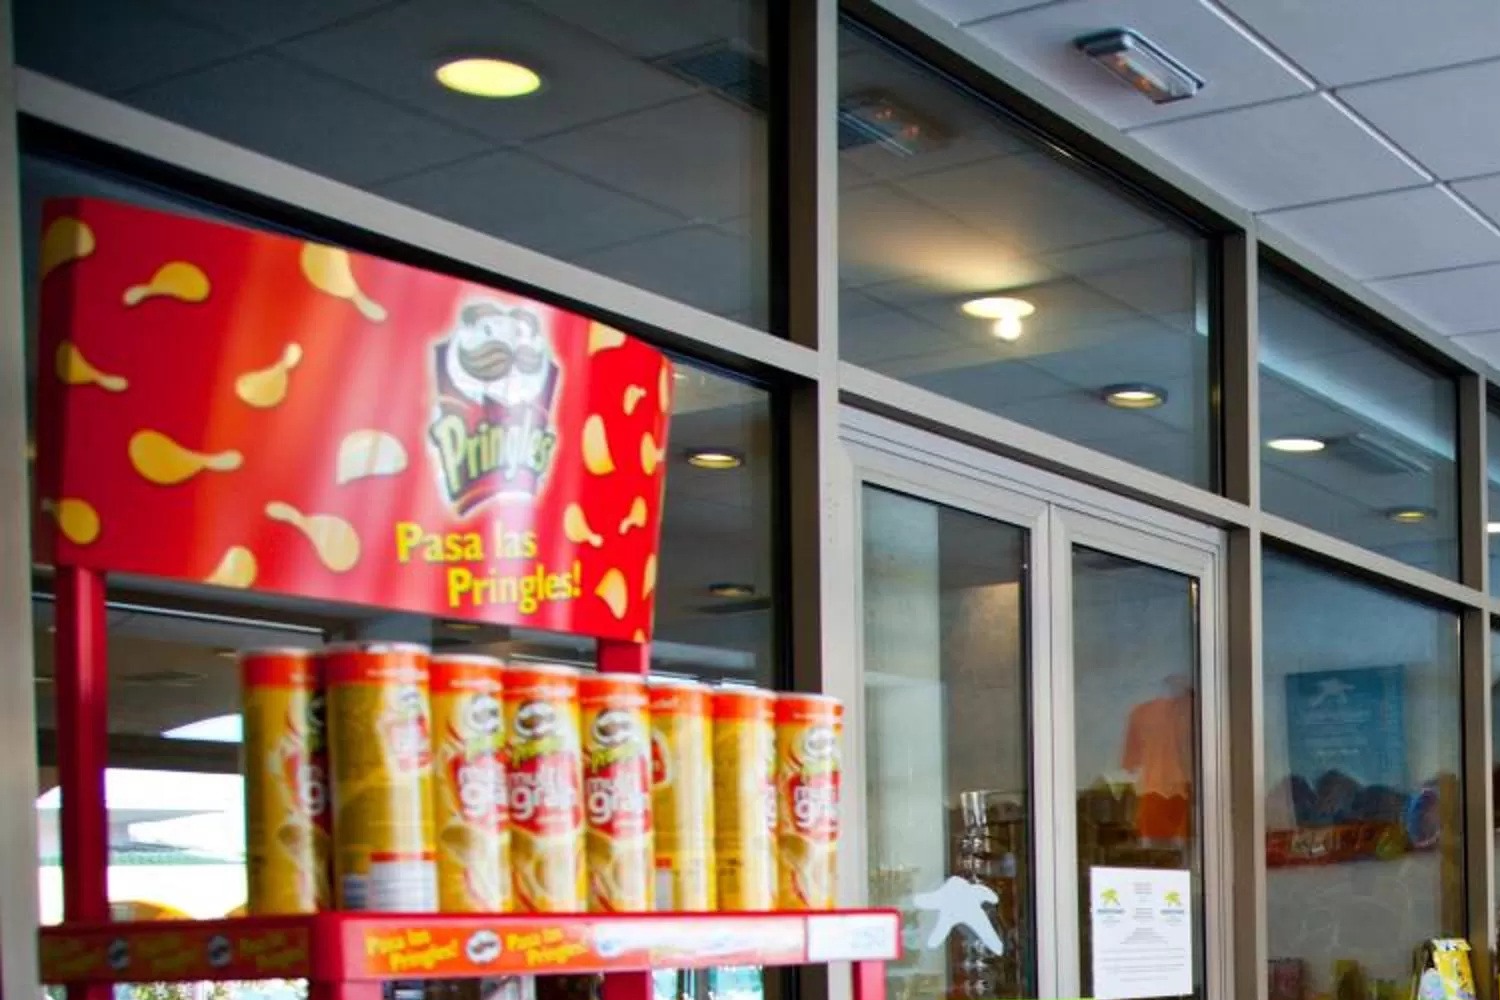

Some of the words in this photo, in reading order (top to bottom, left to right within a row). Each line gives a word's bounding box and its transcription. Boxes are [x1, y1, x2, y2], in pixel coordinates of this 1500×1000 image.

[430, 412, 555, 496] Pringles
[396, 522, 483, 562] Pasa
[493, 521, 537, 557] las
[447, 562, 581, 614] Pringles!
